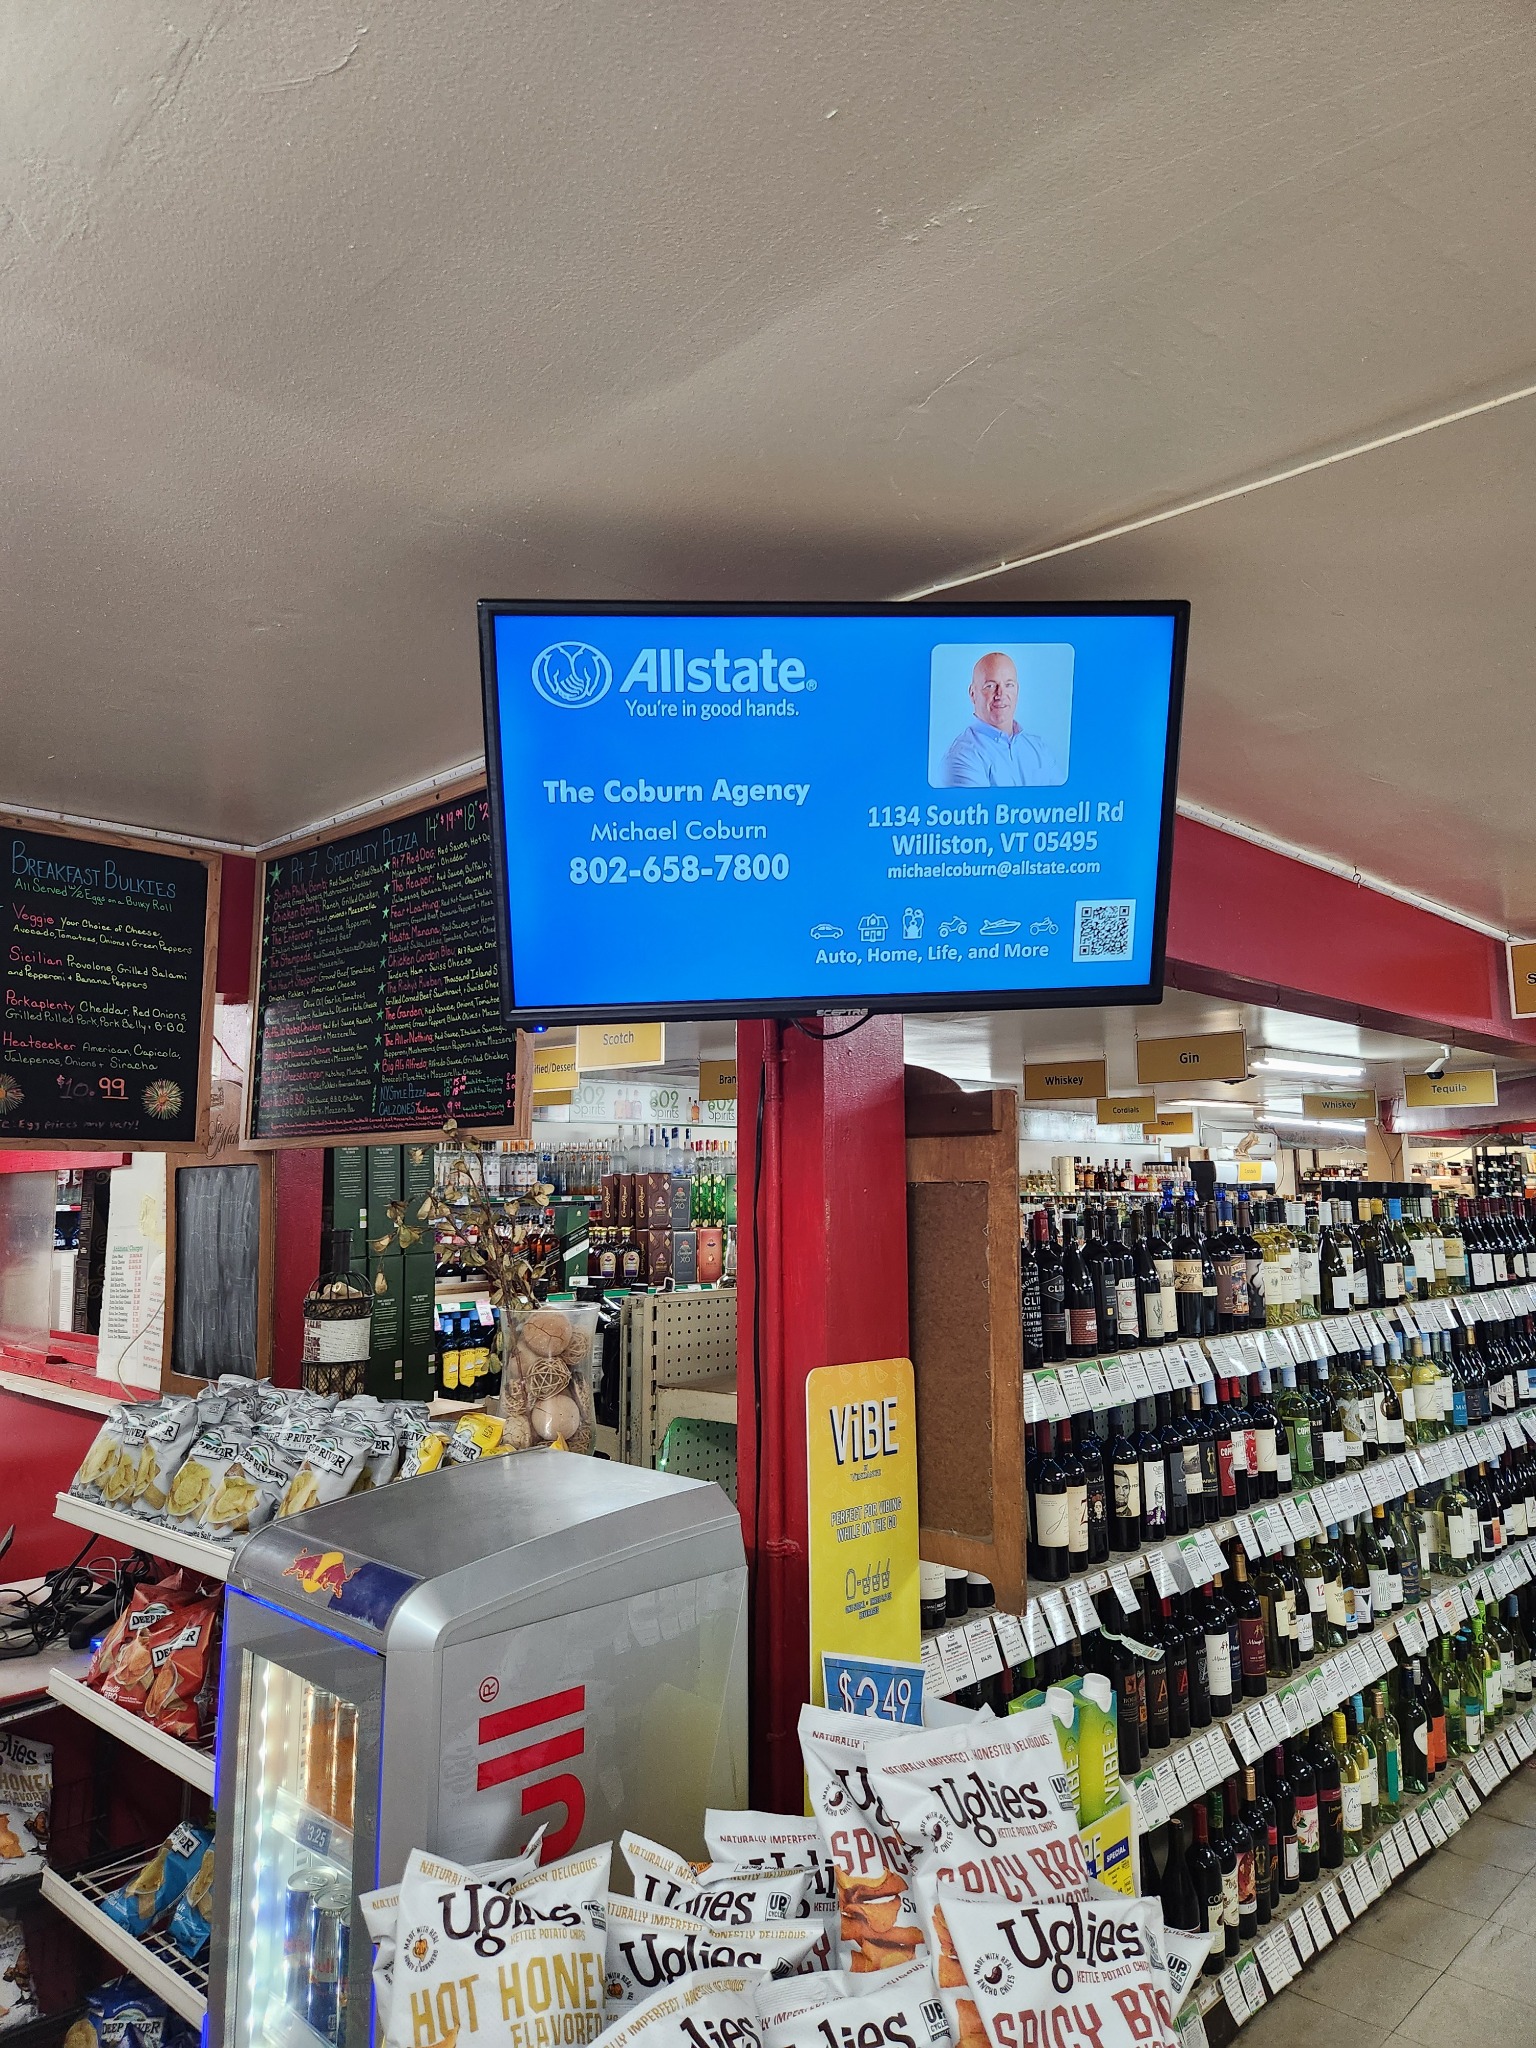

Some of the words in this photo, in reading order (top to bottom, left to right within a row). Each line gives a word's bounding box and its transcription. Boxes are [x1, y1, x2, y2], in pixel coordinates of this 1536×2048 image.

[625, 700, 677, 718] You're
[681, 700, 696, 716] in
[700, 700, 742, 722] good
[746, 700, 800, 718] hands.
[543, 779, 596, 804] The
[602, 780, 703, 804] Coburn
[711, 779, 810, 806] Agency
[868, 806, 920, 828] 1134
[926, 804, 991, 827] South
[996, 801, 1091, 826] Brownell
[1097, 801, 1124, 823] Rd
[591, 819, 680, 843] Michael
[685, 819, 767, 842] Coburn
[892, 833, 995, 859] Williston,
[1000, 832, 1028, 854] VT
[1034, 831, 1098, 853] 05495
[291, 857, 306, 884] Rt
[308, 850, 319, 879] 7
[325, 841, 379, 875] SPECIALTY
[383, 828, 419, 857] PIZZA
[12, 841, 100, 887] BREAKFAST
[105, 860, 176, 898] BULKIES
[417, 863, 435, 874] Burger
[569, 854, 790, 885] 802-658-7800
[887, 859, 1101, 880] michaelcoburn@allstate.com
[14, 878, 30, 891] All
[32, 878, 68, 896] Served
[85, 889, 105, 906] Eggs
[153, 900, 172, 912] Roll
[13, 903, 54, 925] Veggie
[60, 917, 79, 929] Your
[81, 919, 112, 932] Choice
[125, 924, 162, 939] Cheese,
[391, 906, 405, 918] Fear
[99, 933, 124, 948] Onions
[131, 939, 158, 950] Green
[159, 940, 193, 955] Peppers
[389, 930, 410, 942] Hasta
[9, 946, 62, 966] Sicilian
[67, 955, 113, 974] Provolone,
[117, 964, 148, 976] Grilled
[152, 967, 187, 980] Salami
[815, 948, 861, 967] Auto,
[867, 946, 922, 966] Home,
[928, 944, 964, 964] Life,
[968, 944, 999, 961] and
[1003, 942, 1049, 960] More
[24, 964, 65, 982] Pepperoni
[76, 973, 110, 985] Banana
[112, 975, 148, 990] Peppers
[410, 966, 423, 976] Ham
[429, 961, 446, 973] Swiss
[448, 958, 473, 969] Cheese
[471, 966, 492, 979] Island
[6, 989, 75, 1014] Porkaplenty
[80, 1001, 130, 1016] Cheddar,
[132, 1006, 150, 1017] Red
[152, 1008, 187, 1021] Onions,
[385, 1007, 396, 1020] The
[5, 1008, 42, 1021] Grilled
[44, 1012, 73, 1024] Pulled
[77, 1014, 99, 1028] Pork,
[100, 1017, 120, 1027] Pork
[122, 1019, 146, 1034] Belly
[3, 1031, 76, 1050] Heatseeker
[134, 1044, 181, 1059] Capicola,
[603, 1030, 635, 1046] Scotch
[64, 1056, 96, 1068] Onions
[110, 1057, 158, 1070] Siracha
[382, 1059, 394, 1075] Big
[534, 1061, 576, 1074] ified/Dessert
[1179, 1051, 1200, 1066] Gin
[719, 1074, 736, 1085] Bran
[1045, 1076, 1084, 1086] Whiskey
[1430, 1081, 1467, 1095] Tequila
[650, 1107, 680, 1120] Spirits
[1112, 1106, 1140, 1114] Cordials
[1321, 1099, 1357, 1112] Whiskey
[831, 1505, 862, 1528] PERFECT
[864, 1503, 877, 1518] FOR
[879, 1497, 902, 1516] VIBING
[837, 1526, 861, 1543] WHILE
[862, 1524, 872, 1537] ON
[873, 1519, 887, 1534] THE
[887, 1515, 897, 1529] GO
[812, 1731, 860, 1749] NATURALLY
[882, 1760, 927, 1775] NATURALLY
[928, 1770, 1048, 1848] Uglies
[719, 1835, 767, 1844] NATURALLY
[997, 1827, 1017, 1839] KETTLE
[1018, 1824, 1039, 1837] POTATO
[1039, 1820, 1058, 1833] CHIPS
[628, 1843, 674, 1873] NATURALLY
[1106, 1844, 1127, 1863] SPECIAL
[814, 1902, 836, 1912] KETTLE
[510, 1930, 537, 1945] KETTLE
[538, 1929, 568, 1940] POTATO
[997, 1903, 1145, 1994] Uglies
[973, 1961, 985, 1976] MADE
[985, 1952, 999, 1962] WITH
[1001, 1955, 1014, 1971] REAL
[1077, 1970, 1100, 1984] KETTLE
[1103, 1965, 1131, 1982] POTATO
[976, 1980, 998, 1997] ANCHO
[999, 1974, 1016, 1996] CHILES
[410, 1974, 480, 2048] HOT
[102, 2022, 124, 2035] DEEP
[992, 2003, 1103, 2048] SPICY
